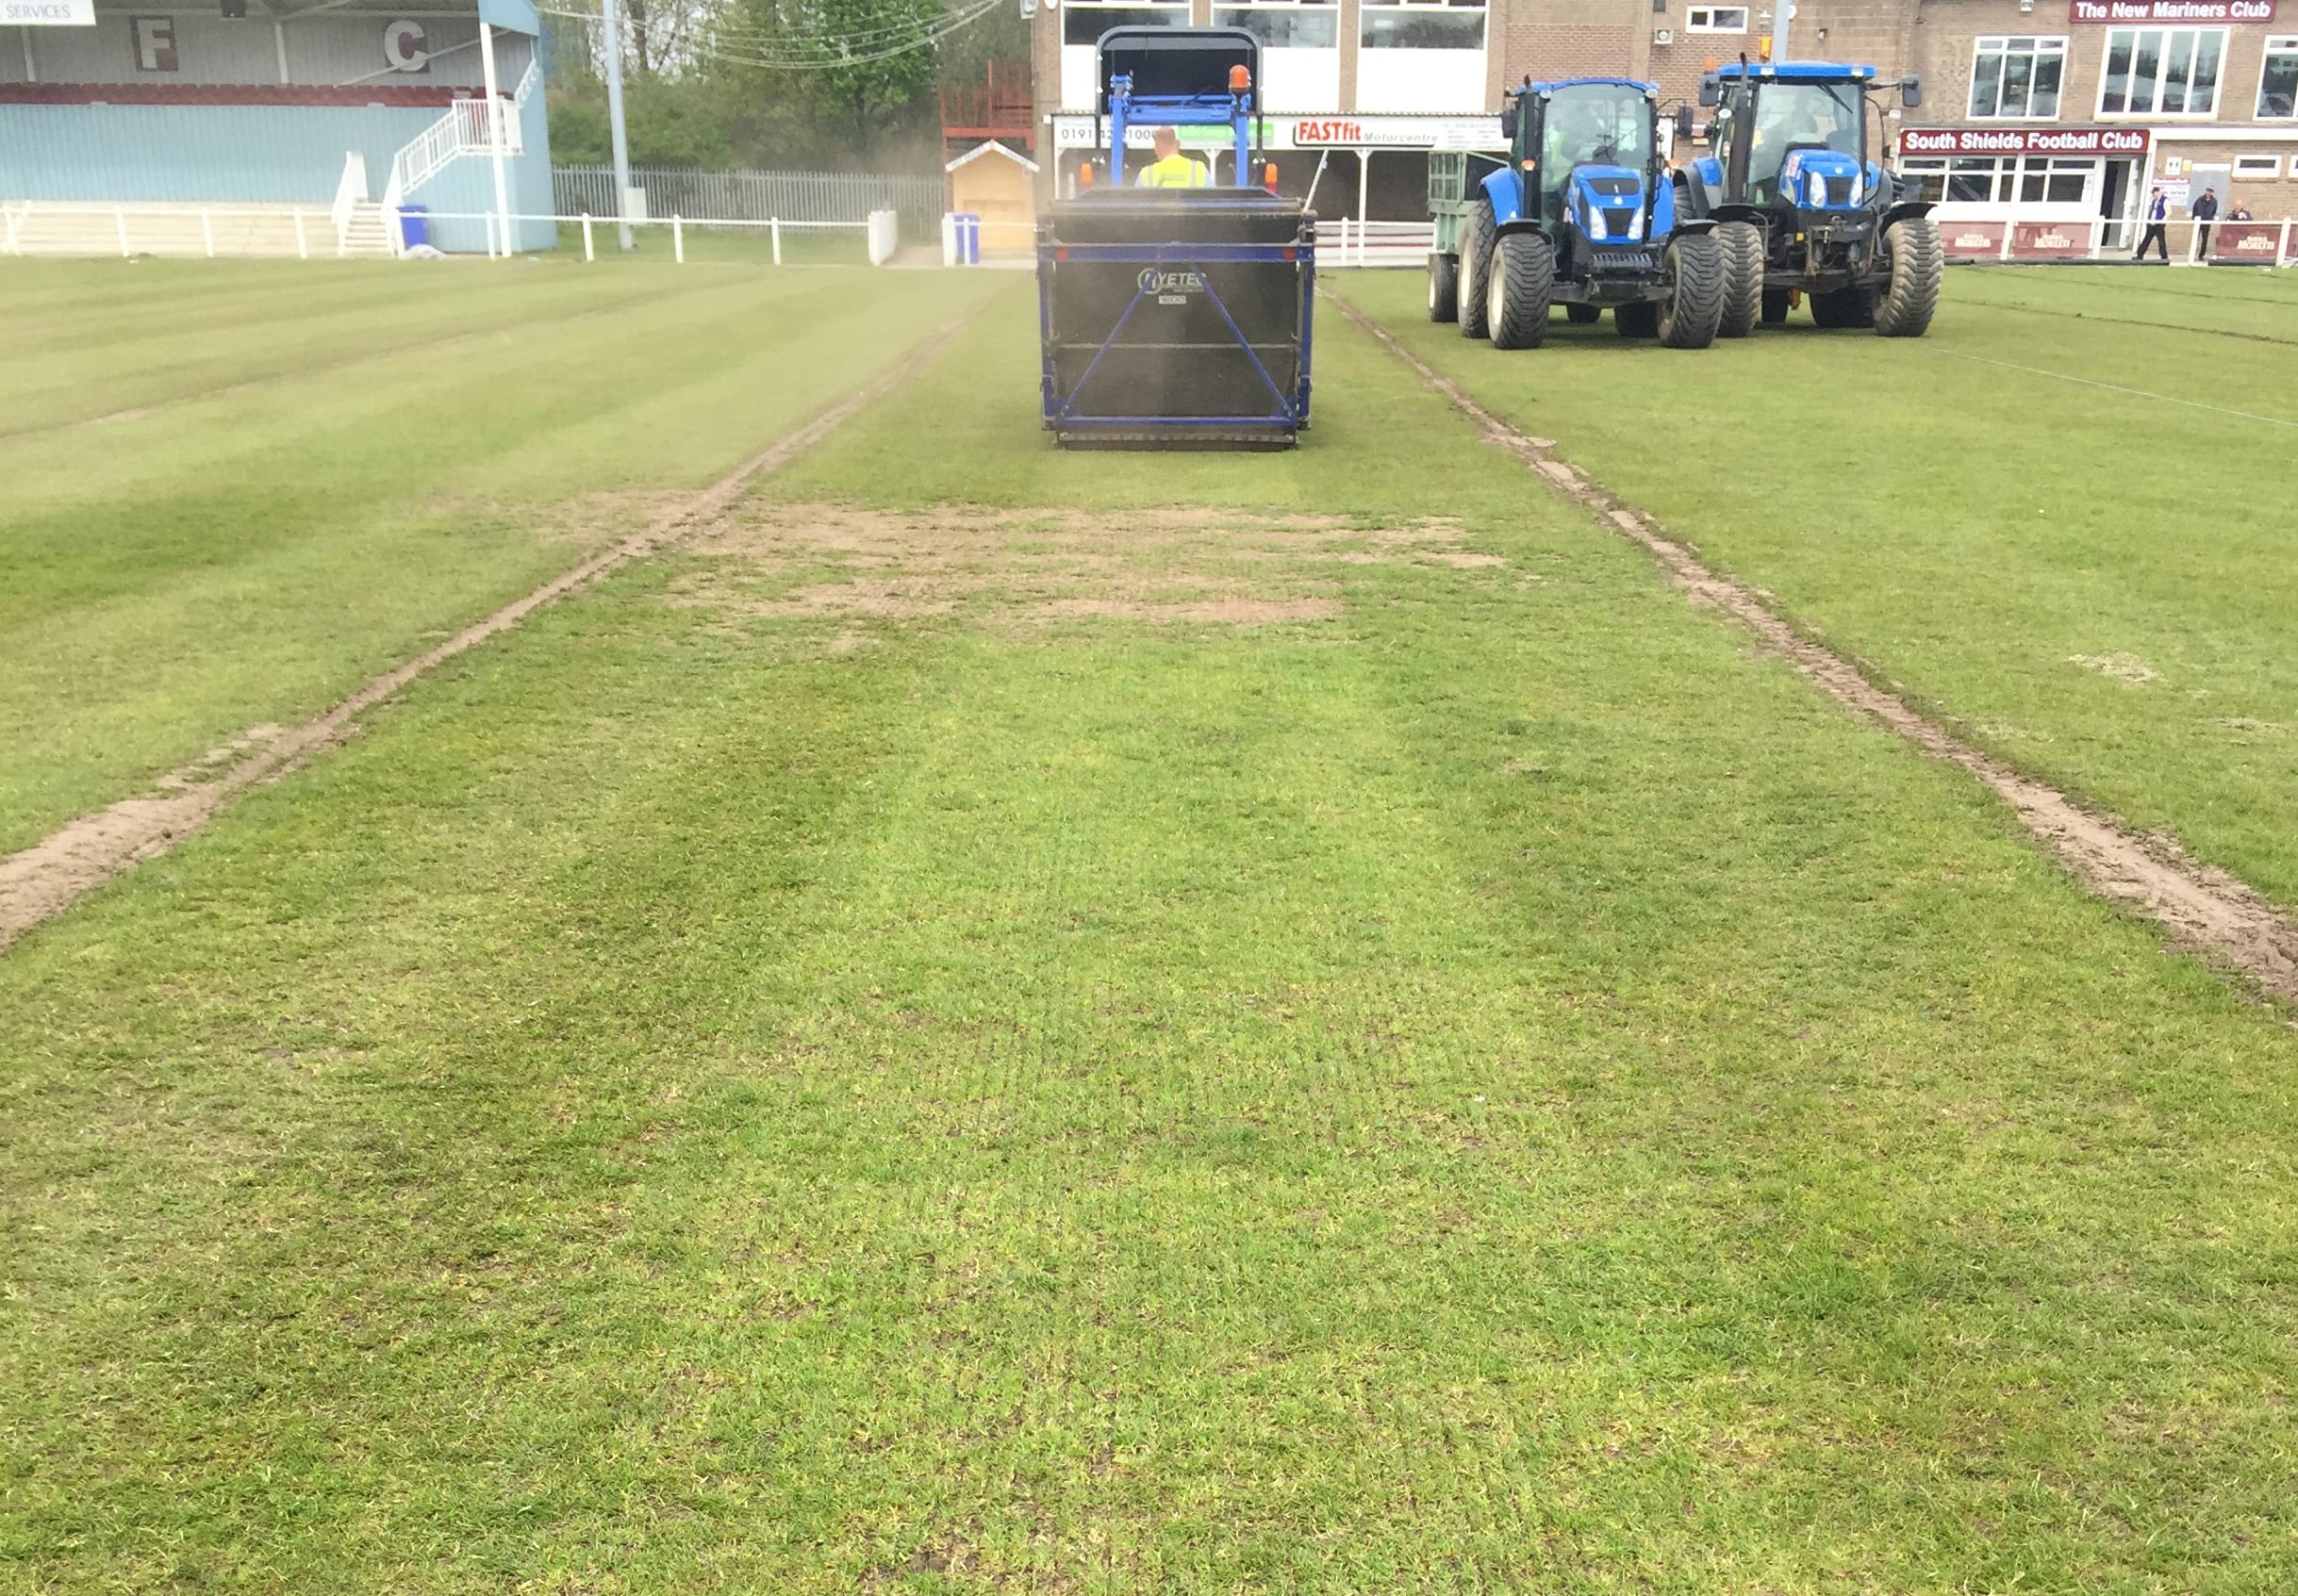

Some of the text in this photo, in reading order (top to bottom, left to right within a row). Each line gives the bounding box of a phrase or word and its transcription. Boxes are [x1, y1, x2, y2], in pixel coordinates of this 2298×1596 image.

[6, 4, 72, 19] SERVICES
[2075, 0, 2272, 19] The New Mariners Club
[136, 17, 426, 72] F C
[1061, 128, 1093, 140] 0191
[1298, 121, 1362, 141] FASTfit
[1364, 132, 1438, 142] Motorcentre
[1905, 132, 2143, 150] South Shields Football Club
